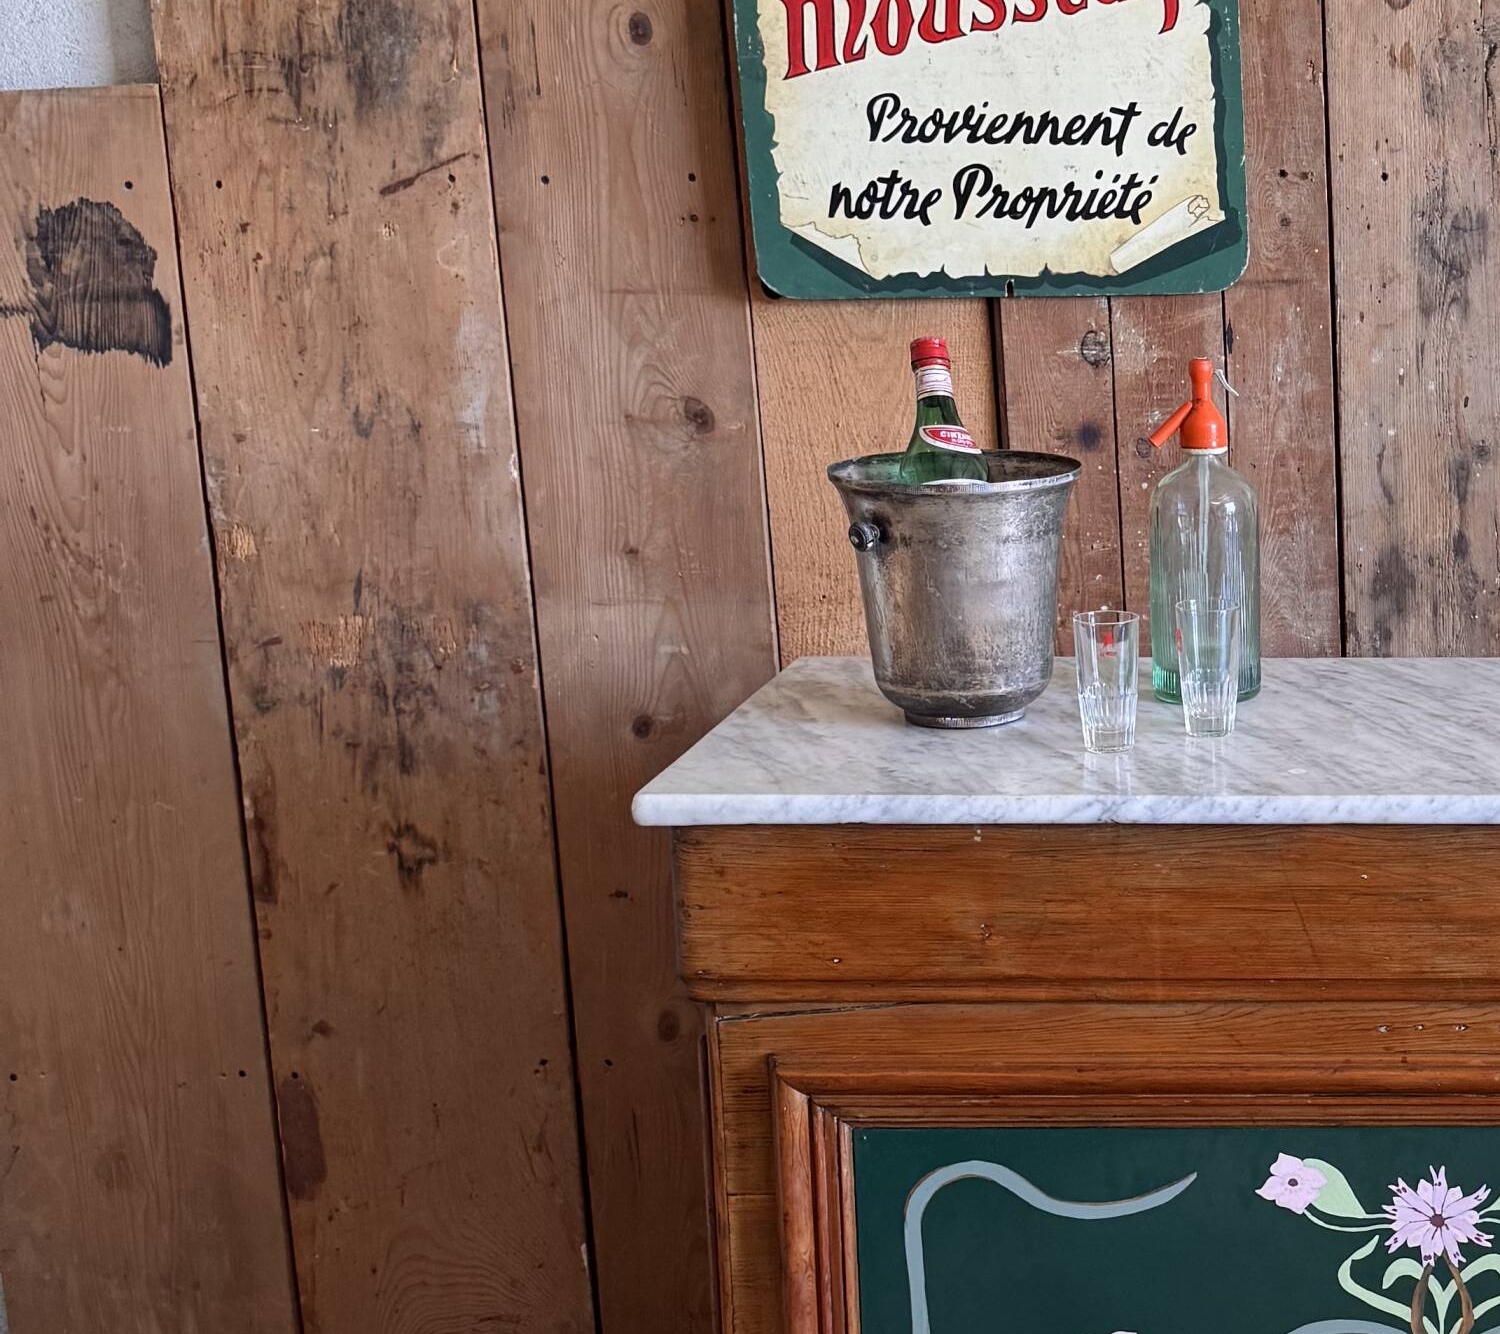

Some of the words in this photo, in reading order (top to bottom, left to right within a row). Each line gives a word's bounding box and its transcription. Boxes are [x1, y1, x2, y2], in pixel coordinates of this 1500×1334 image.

[866, 92, 1142, 157] Proviennent
[1147, 106, 1197, 156] de
[828, 169, 943, 227] notre
[952, 163, 1159, 229] Propriété
